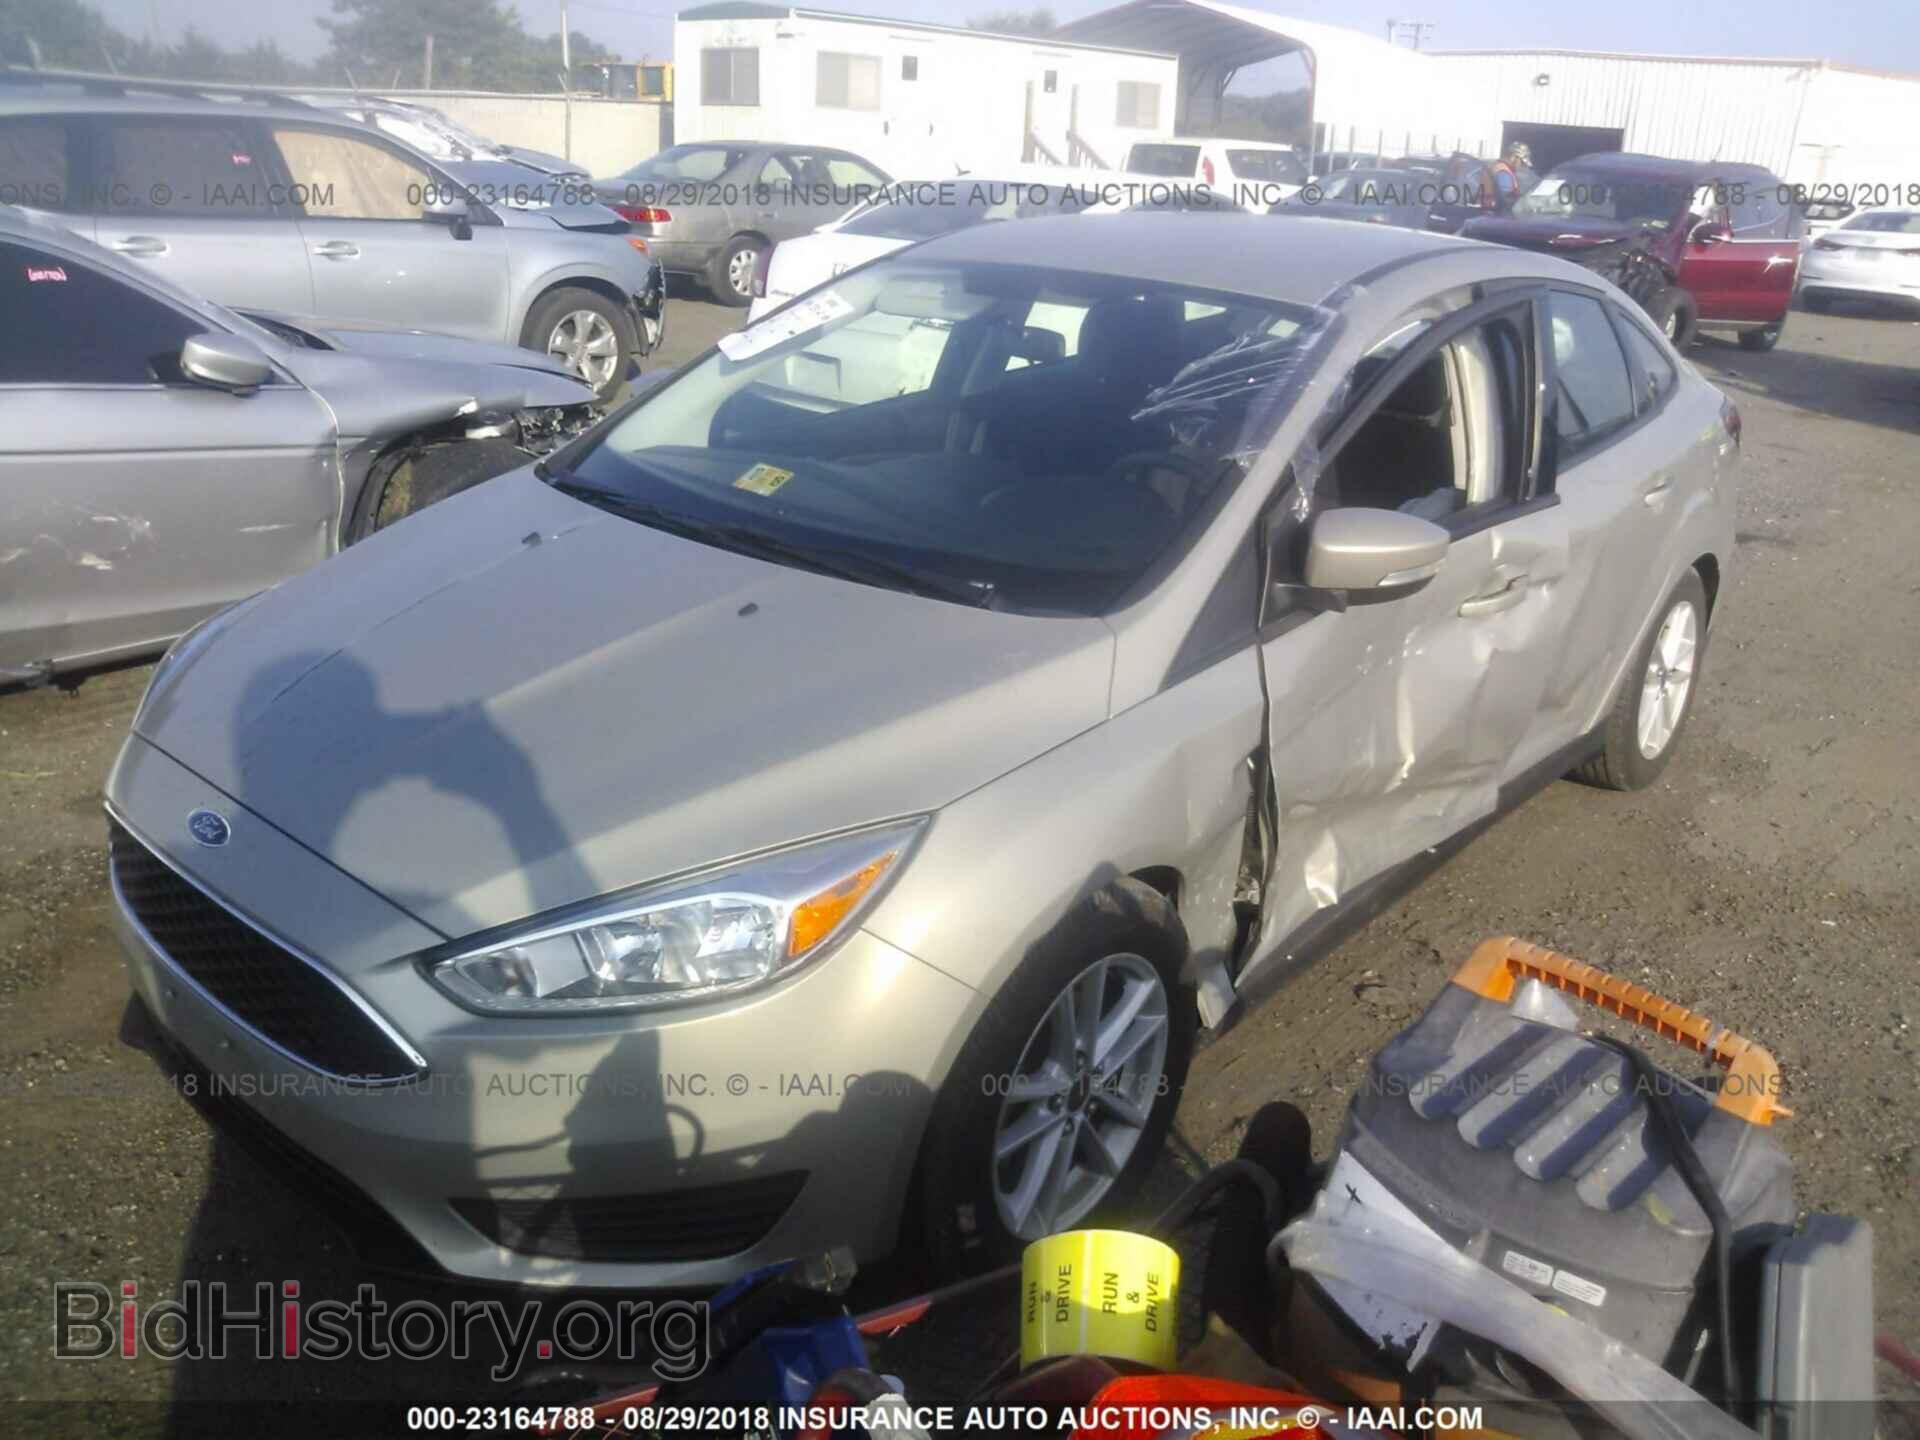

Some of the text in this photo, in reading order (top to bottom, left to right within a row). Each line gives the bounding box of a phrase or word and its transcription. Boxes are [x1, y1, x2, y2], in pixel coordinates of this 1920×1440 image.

[1056, 1263, 1072, 1322] DRIVE
[1102, 1272, 1119, 1314] RUN
[1126, 1291, 1140, 1303] &
[1145, 1271, 1159, 1332] DRIVE
